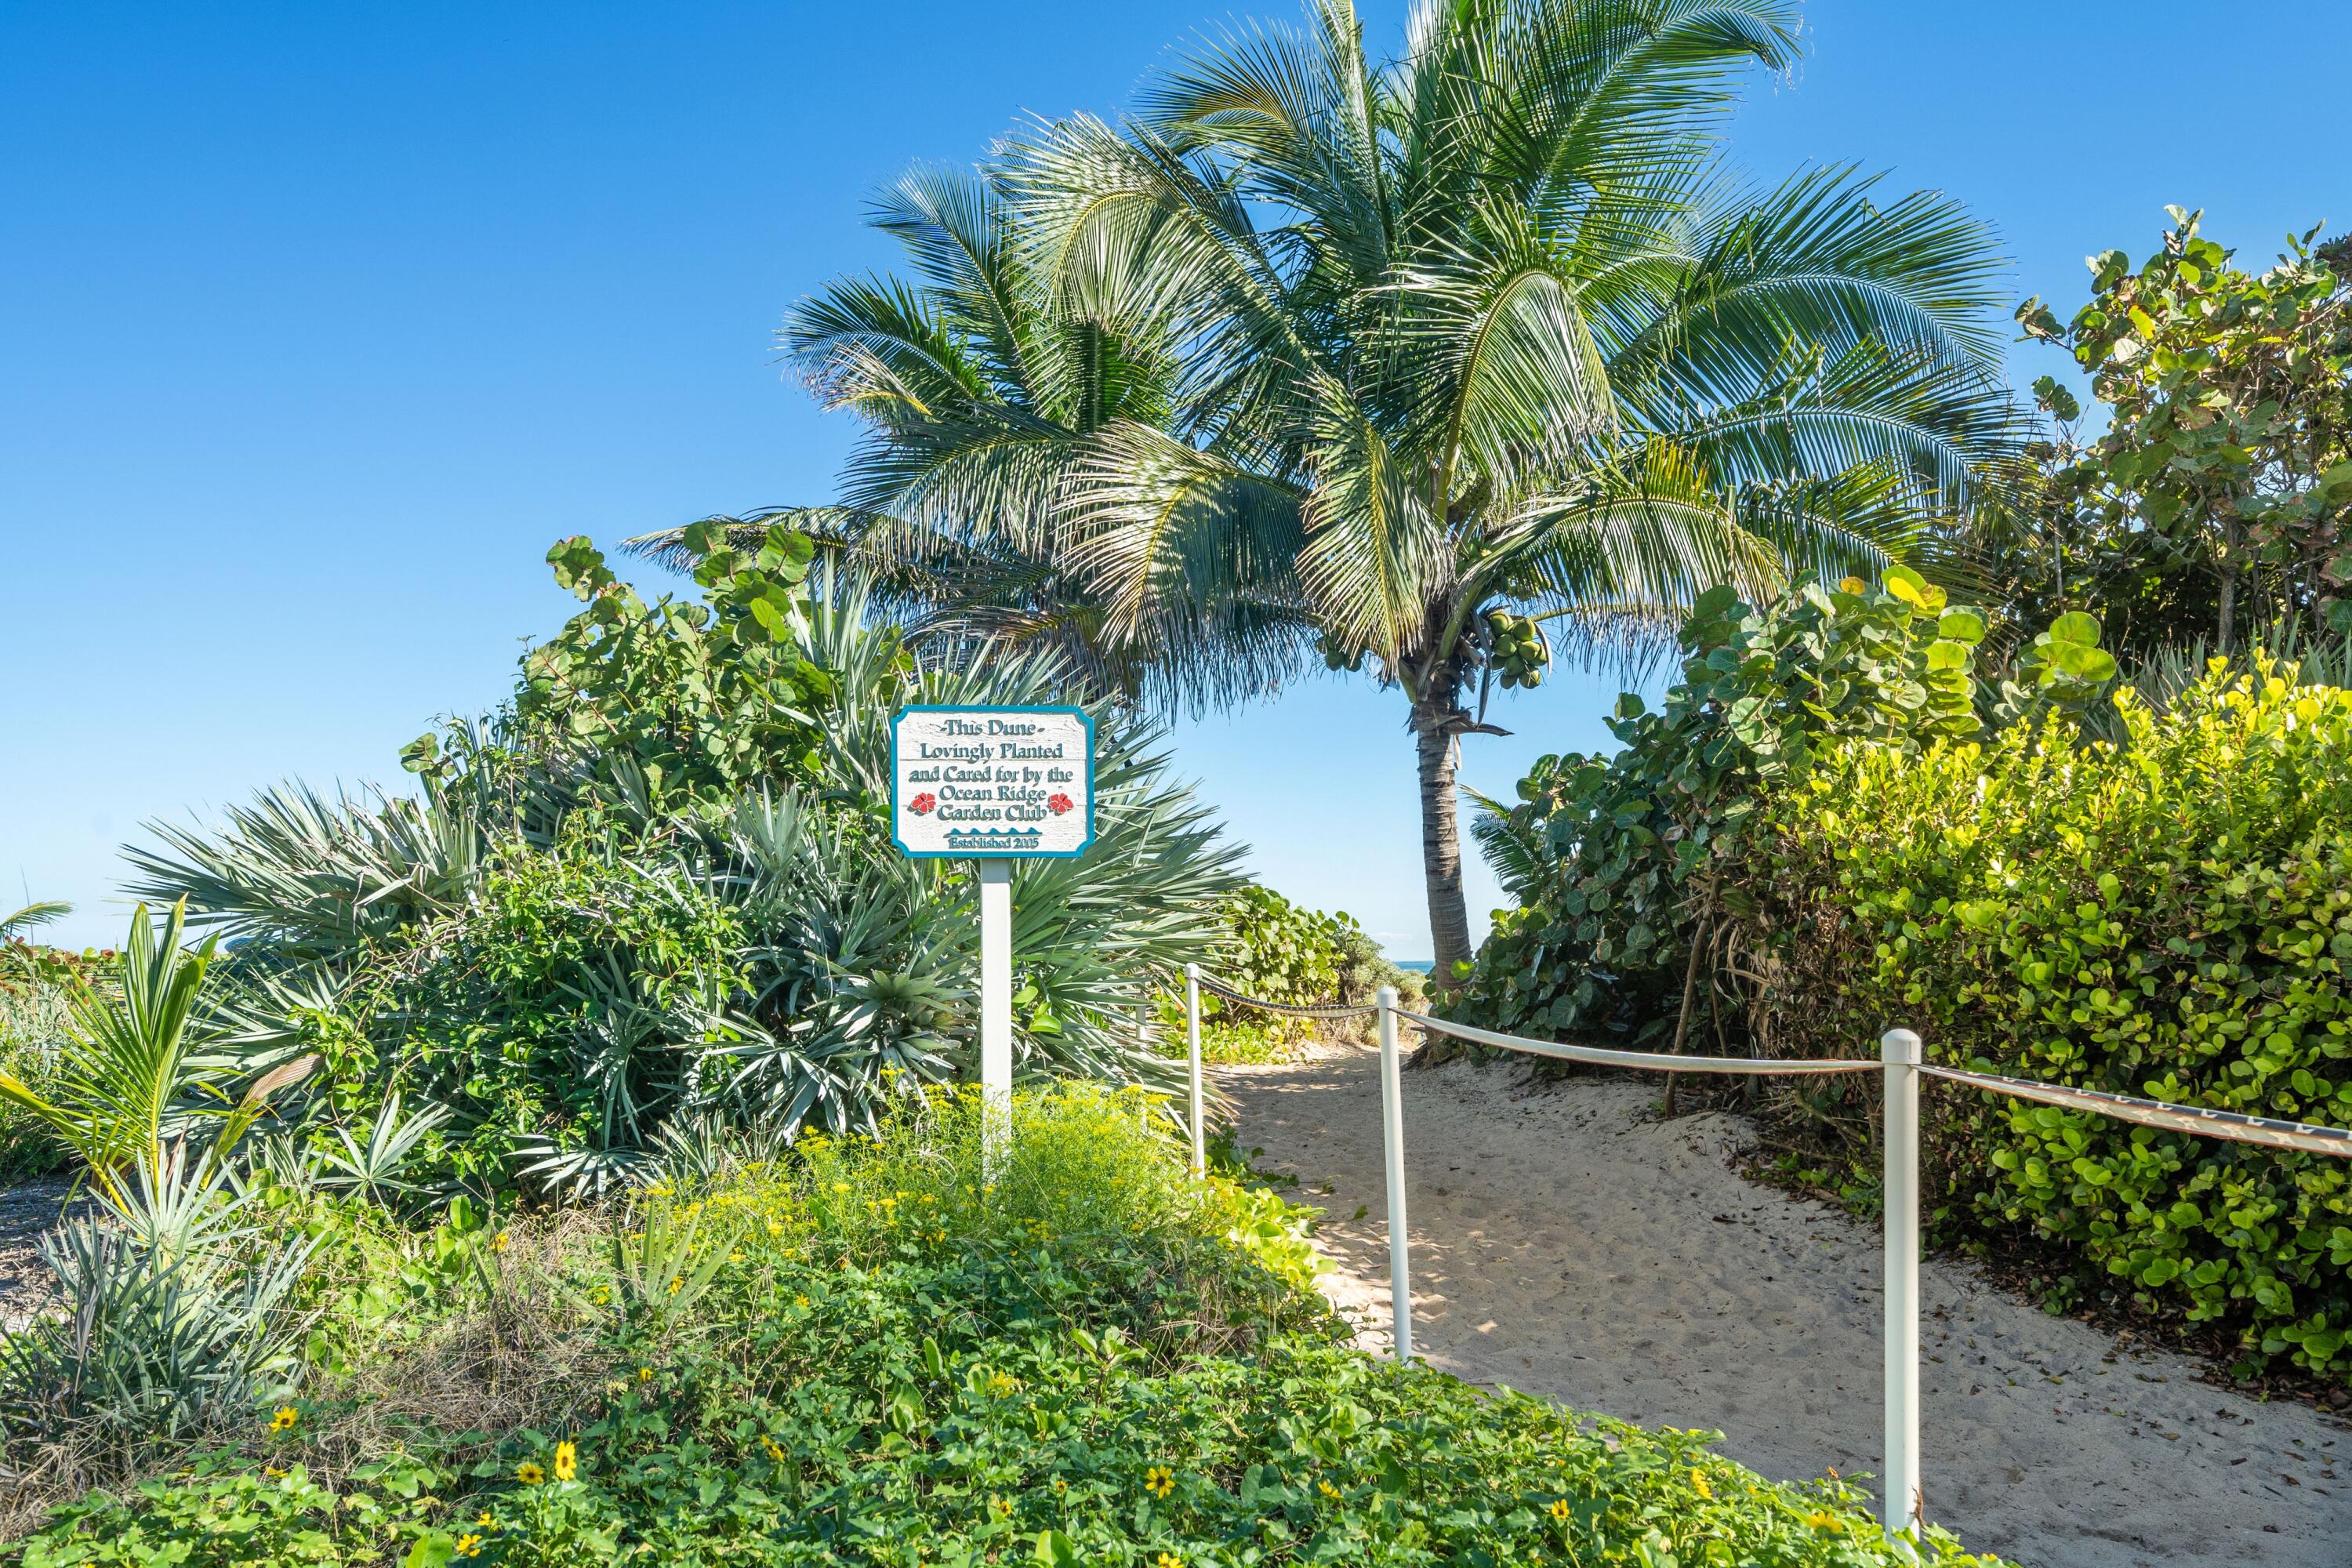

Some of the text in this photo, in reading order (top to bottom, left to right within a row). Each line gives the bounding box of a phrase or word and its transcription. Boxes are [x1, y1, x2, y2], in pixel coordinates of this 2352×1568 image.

[920, 742, 1063, 764] Lovingly Planted
[909, 766, 1073, 787] and Cared for by the
[938, 785, 1047, 805] Ocean Ridge
[937, 804, 1047, 821] Garden Club
[949, 837, 1040, 848] Established 2005
